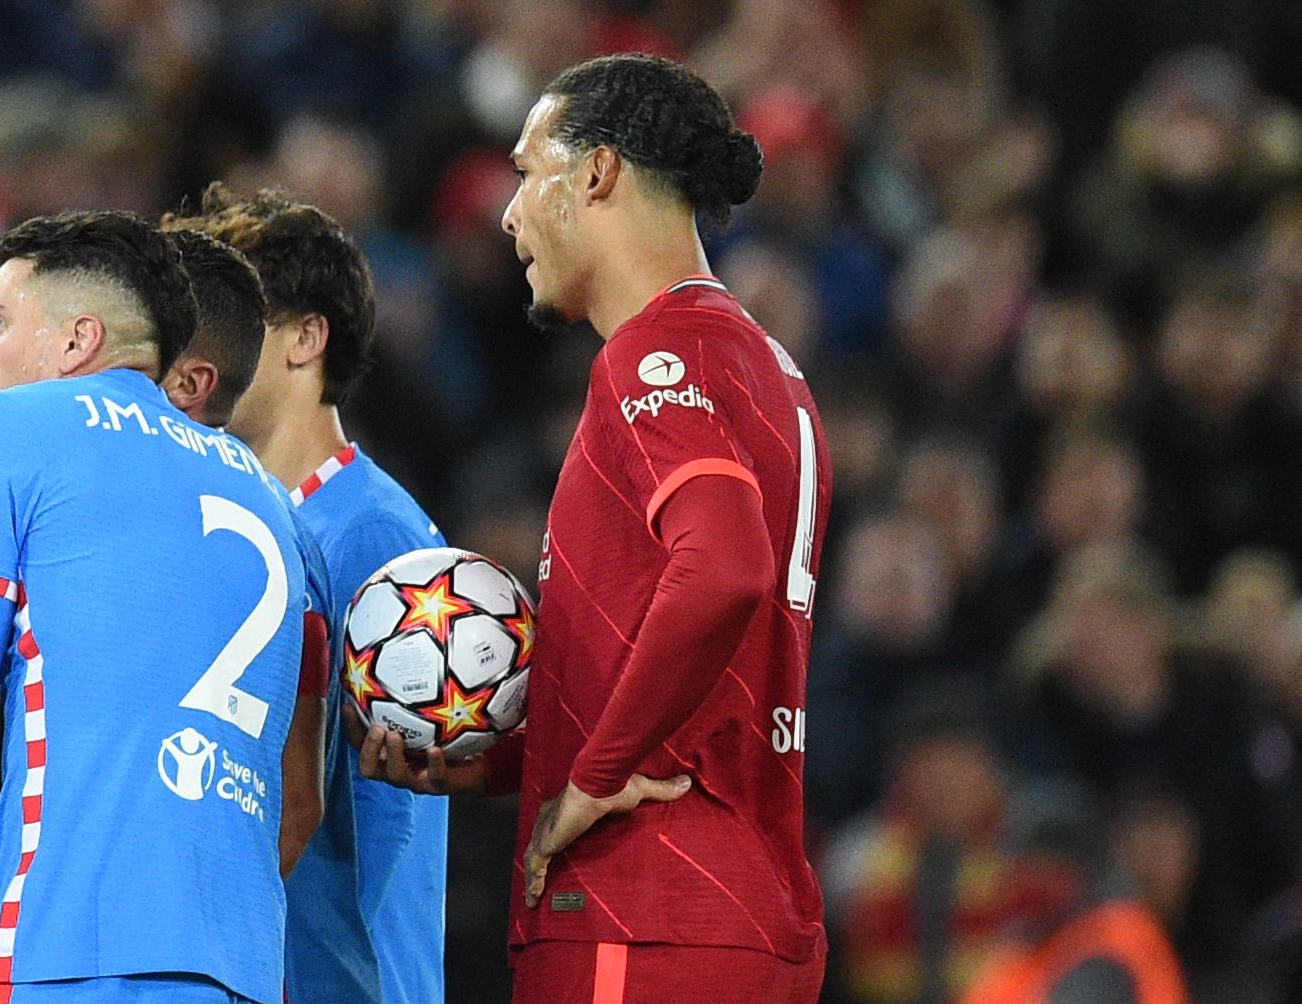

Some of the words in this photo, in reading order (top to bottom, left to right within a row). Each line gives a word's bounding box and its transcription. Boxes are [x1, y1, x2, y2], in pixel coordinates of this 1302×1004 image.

[74, 395, 159, 436] J.M.
[620, 384, 715, 425] Expedia
[178, 495, 288, 740] 2
